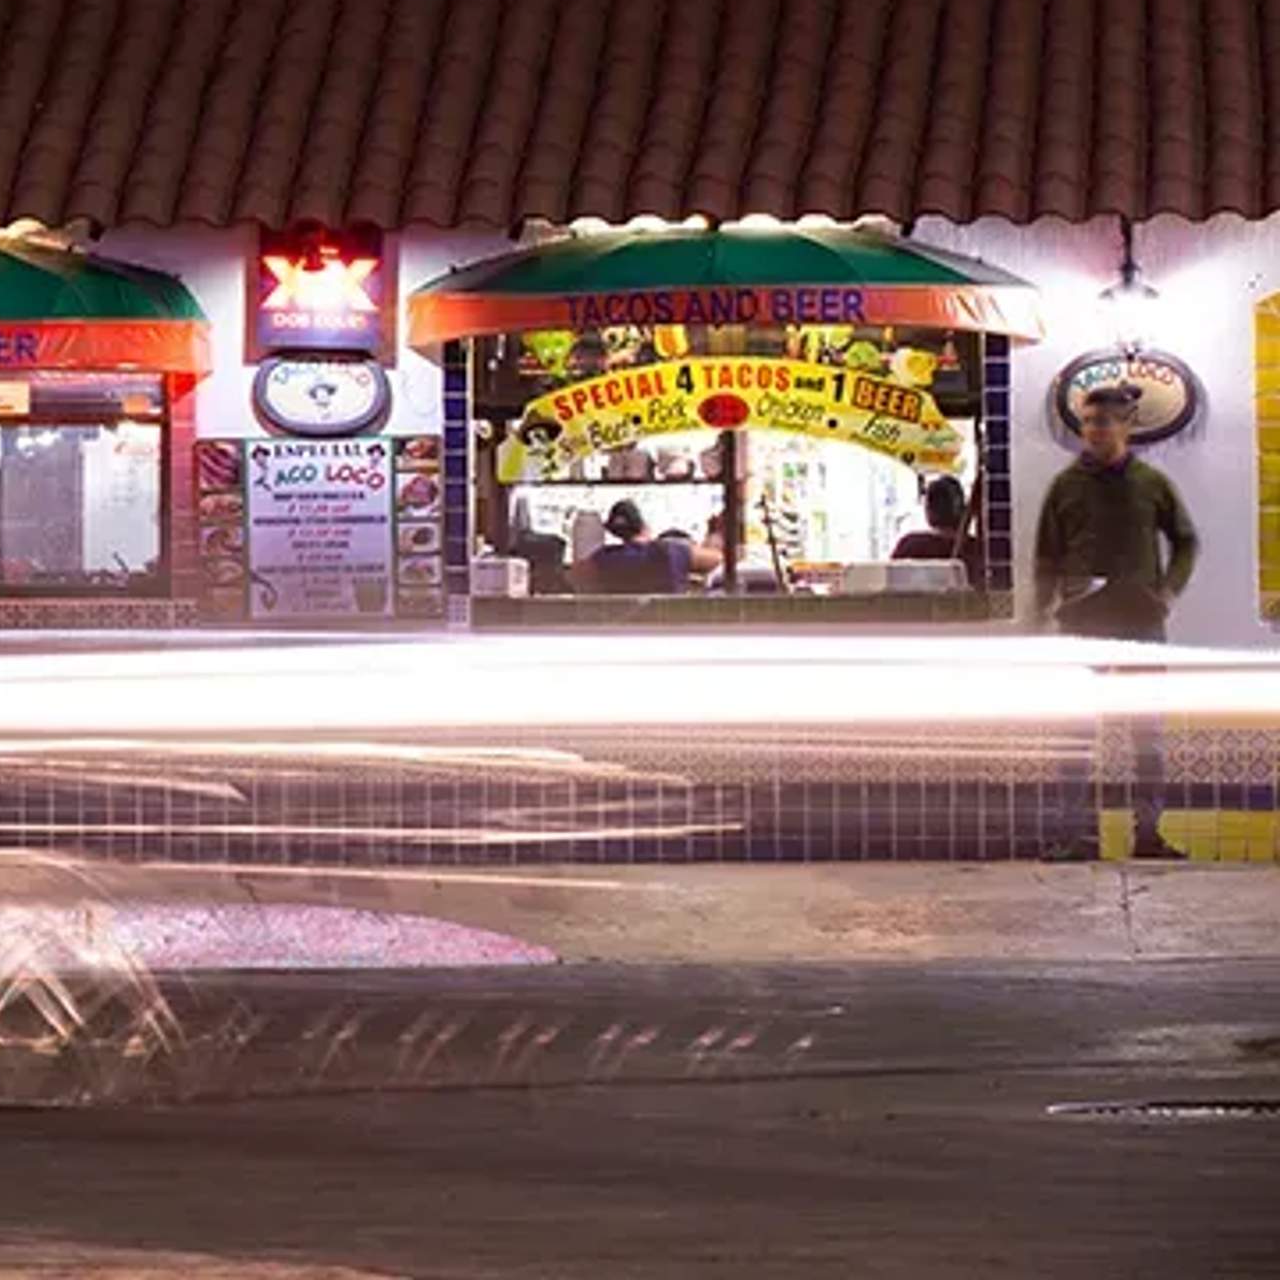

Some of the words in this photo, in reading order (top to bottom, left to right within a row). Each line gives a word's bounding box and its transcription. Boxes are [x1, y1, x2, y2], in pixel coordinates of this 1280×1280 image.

[564, 291, 675, 326] TACOS
[684, 288, 759, 324] AND
[771, 288, 865, 323] BEER
[553, 370, 668, 422] SPECIAL
[675, 365, 694, 394] 4
[702, 363, 791, 393] TACOS
[794, 376, 826, 393] and
[832, 373, 845, 403] 1
[854, 376, 922, 423] BEER
[273, 443, 364, 459] ESPECIAL
[325, 464, 386, 492] LOCO
